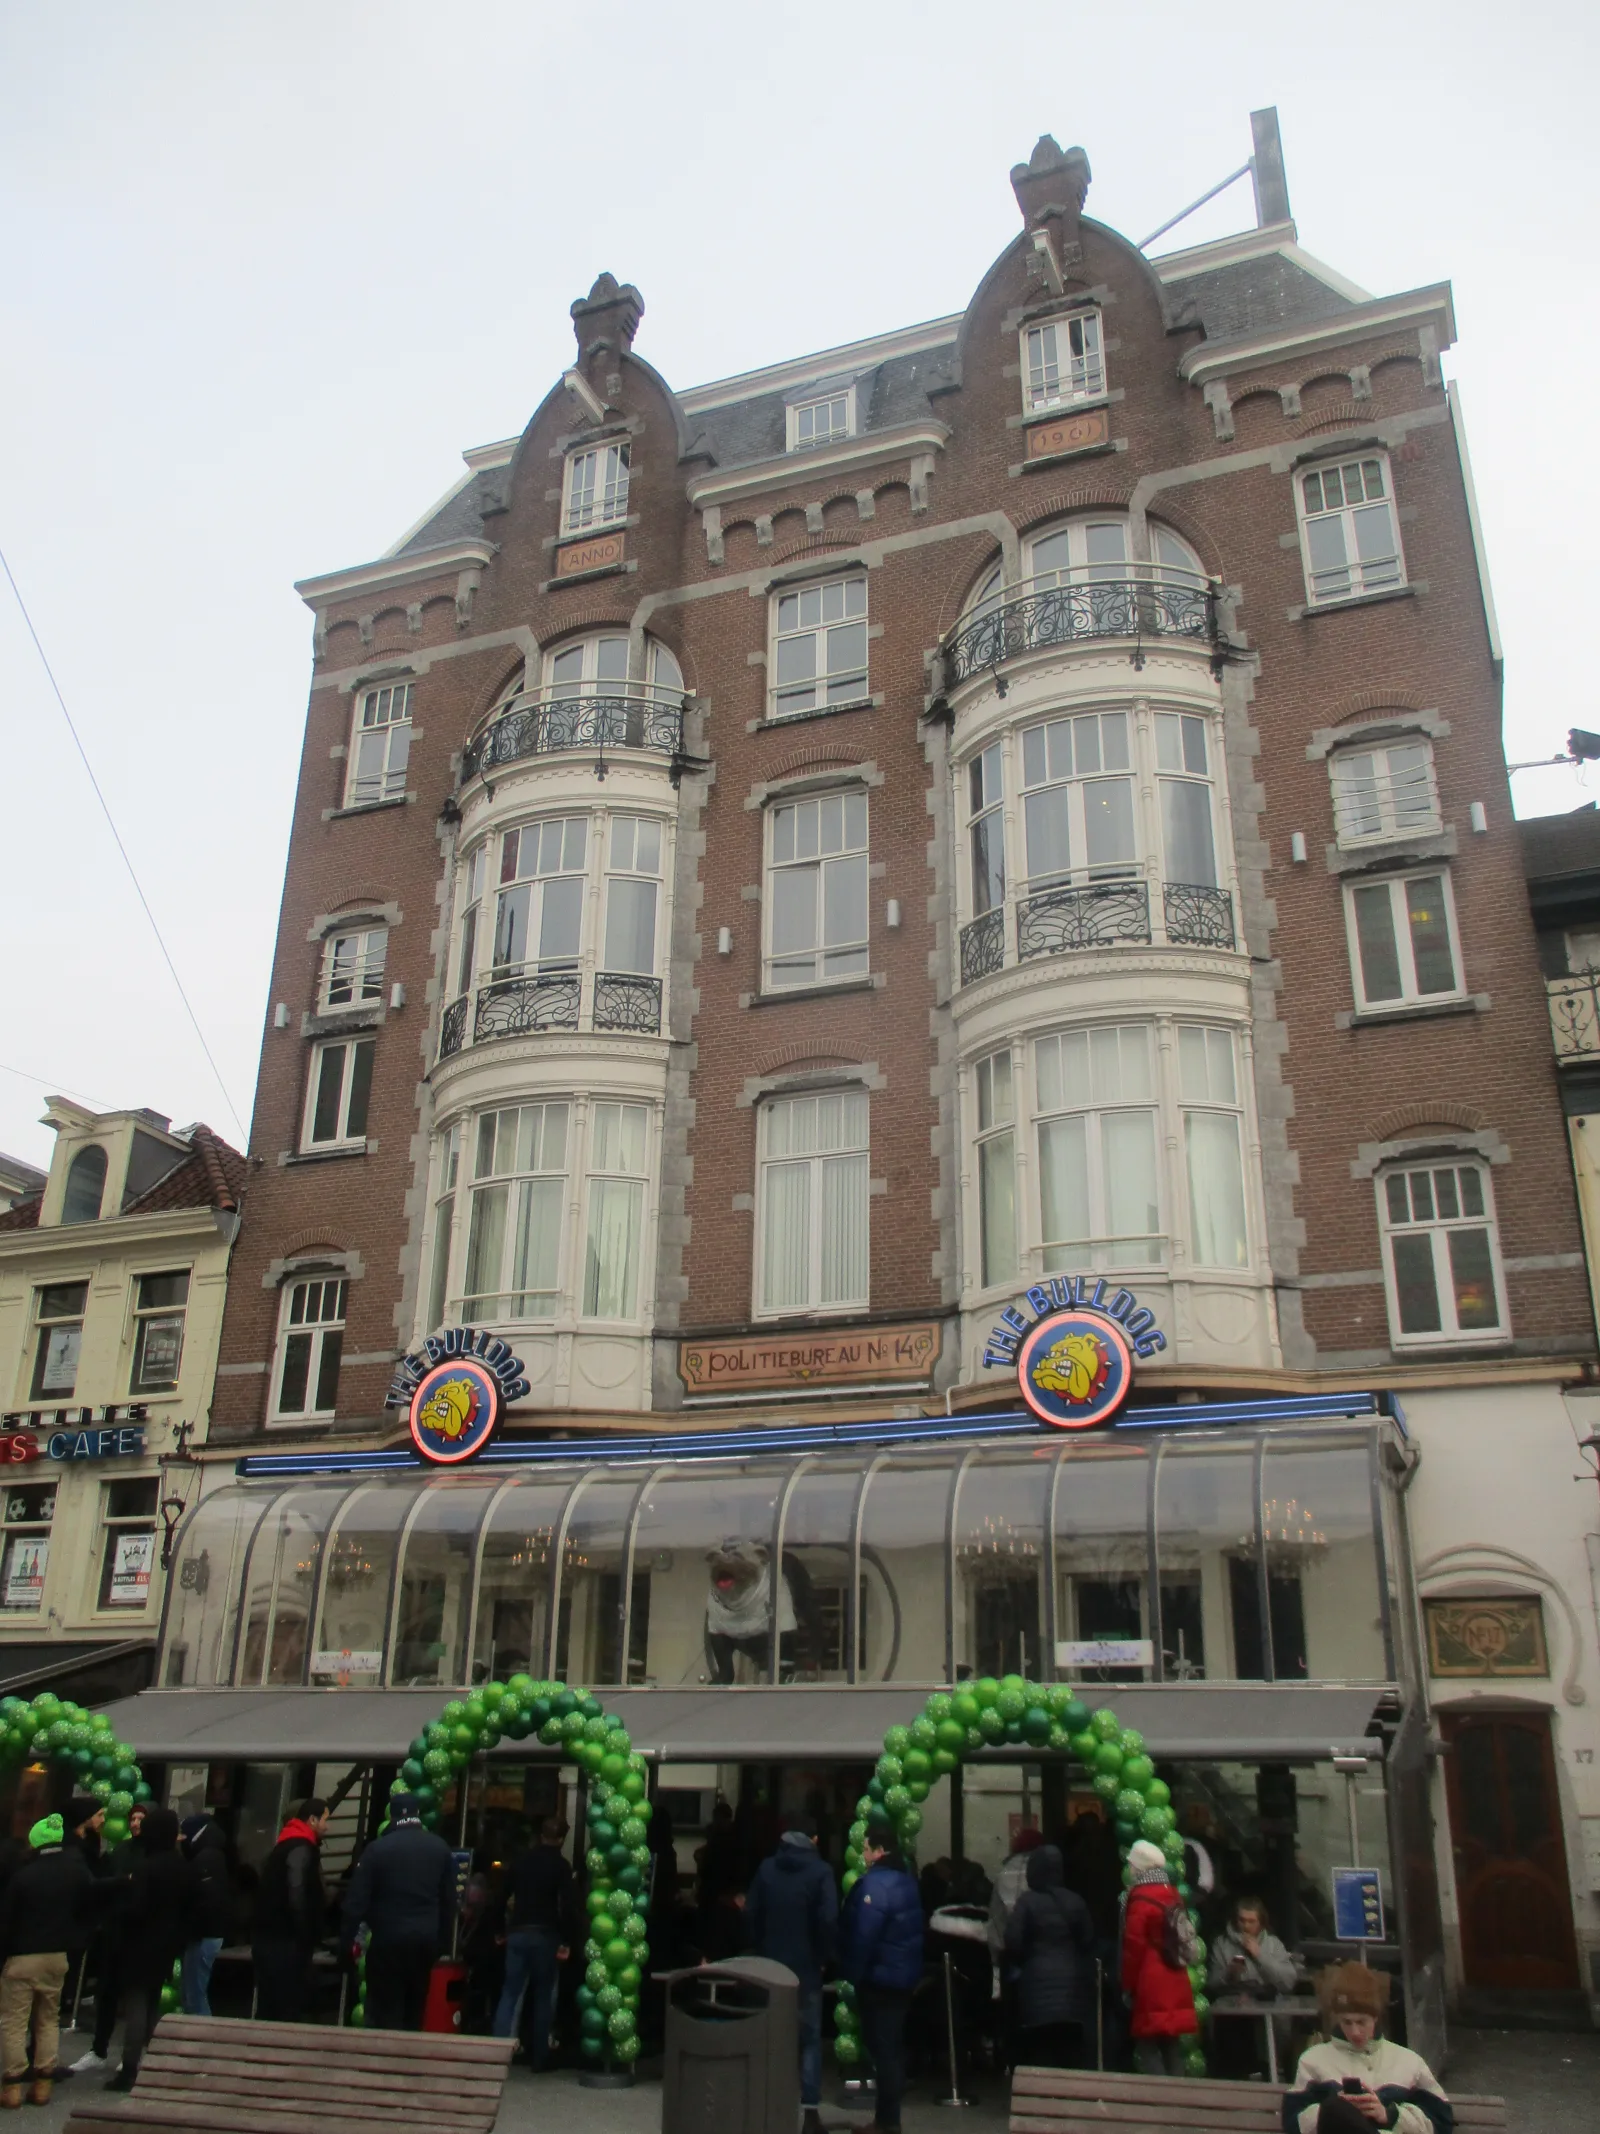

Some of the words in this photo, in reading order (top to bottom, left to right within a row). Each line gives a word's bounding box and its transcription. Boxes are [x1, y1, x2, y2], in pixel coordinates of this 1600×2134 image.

[569, 545, 615, 567] ANNO
[983, 1305, 1033, 1368] THE
[1025, 1275, 1168, 1360] BULLDOG
[384, 1354, 430, 1410] THE
[424, 1327, 532, 1402] BULLDOG
[708, 1344, 861, 1379] POLITIEBUREAU
[895, 1334, 914, 1361] 14
[48, 1426, 144, 1461] CAFE
